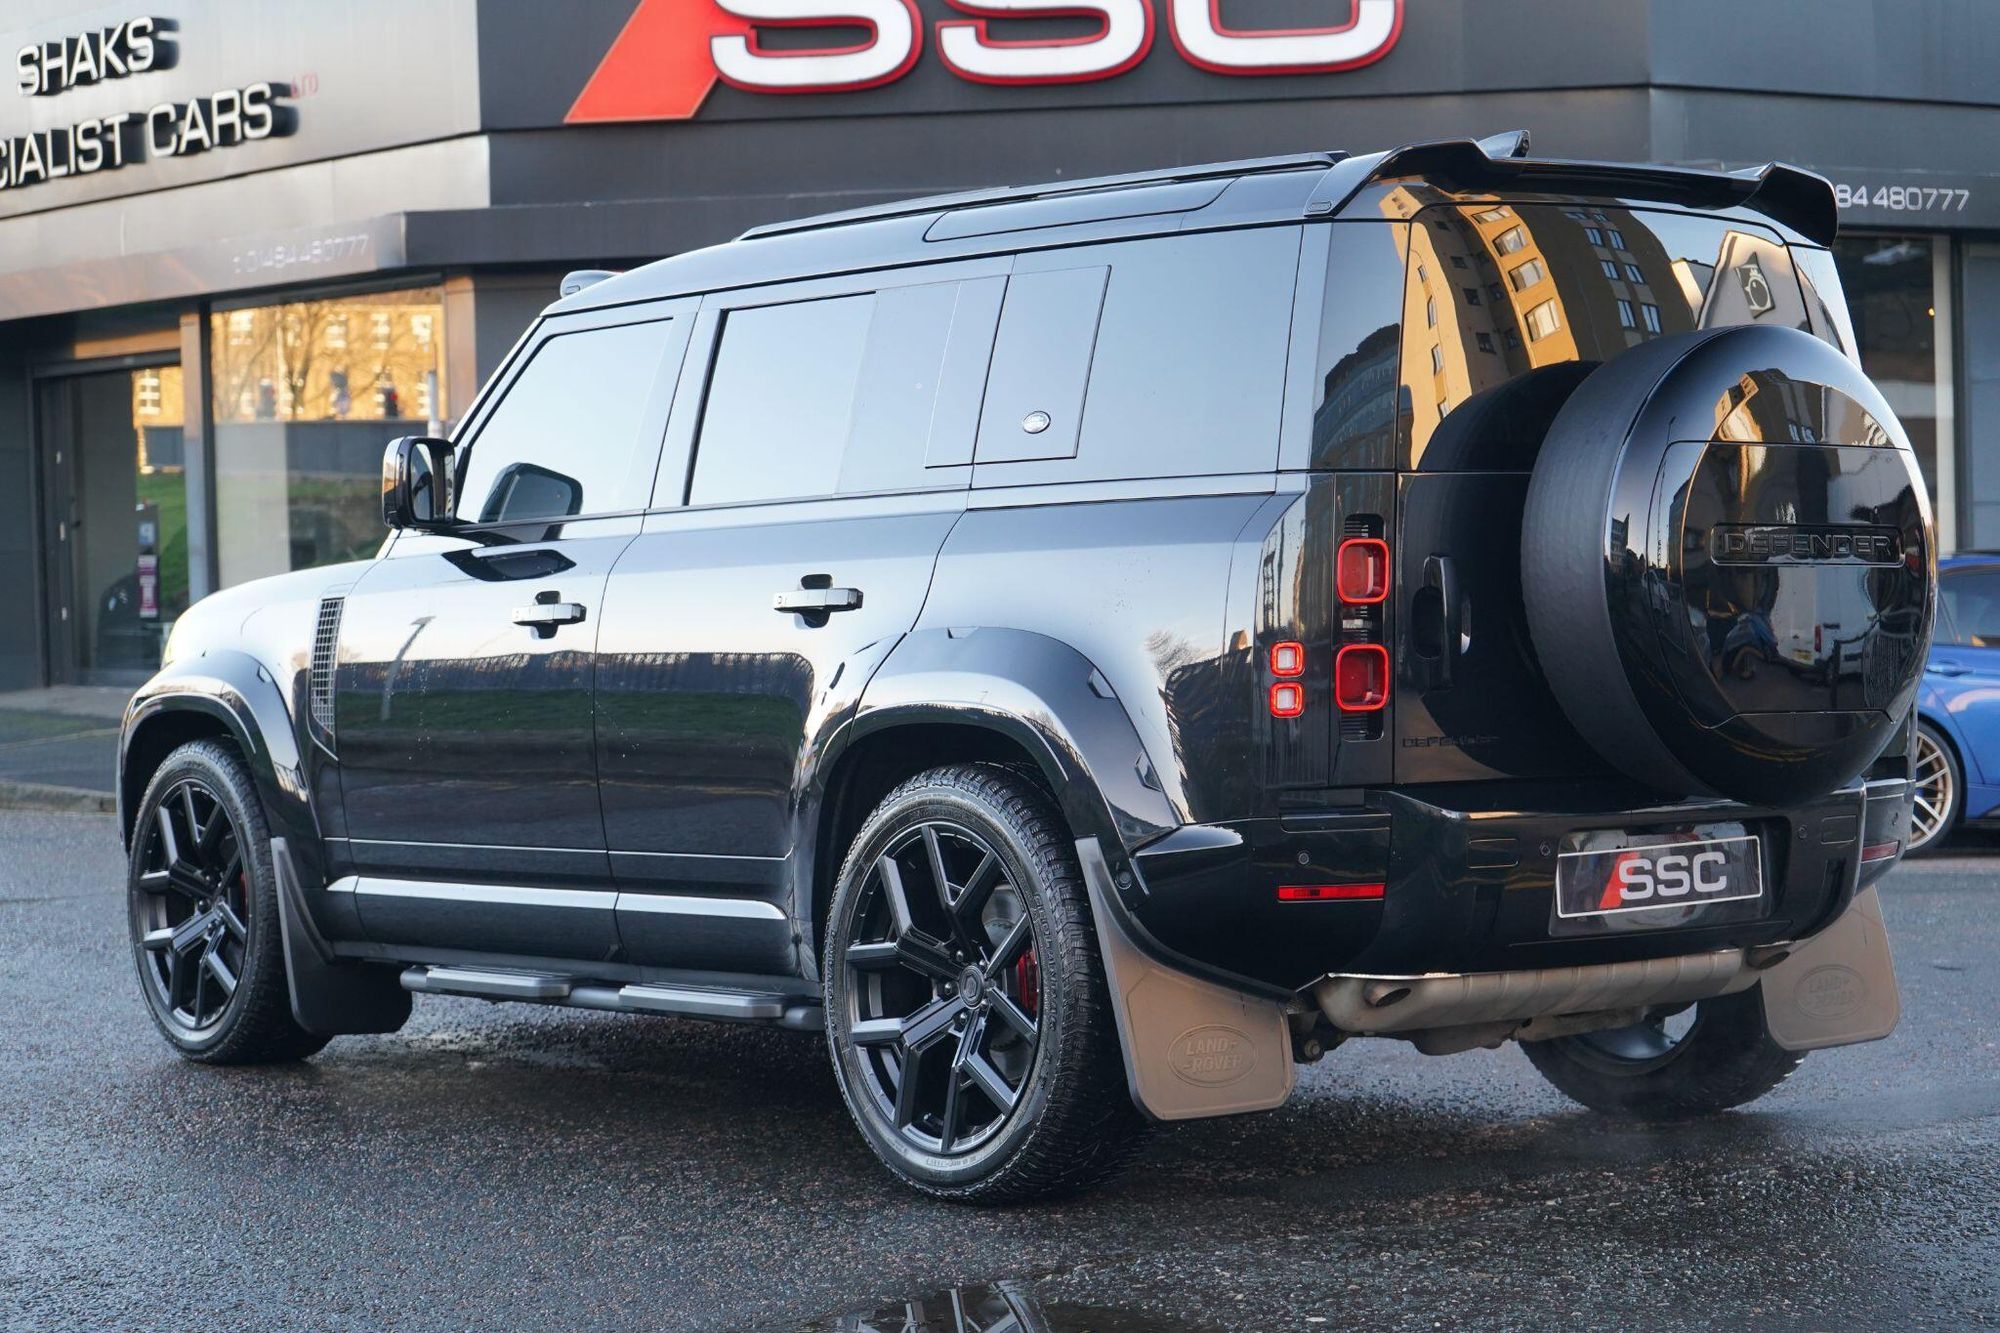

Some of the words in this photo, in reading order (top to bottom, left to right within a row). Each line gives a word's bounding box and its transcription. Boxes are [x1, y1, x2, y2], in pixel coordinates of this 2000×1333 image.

[16, 16, 155, 96] SHAKS
[147, 82, 273, 158] CARS
[1723, 532, 1892, 556] DEFENDER
[1402, 734, 1500, 748] DEFE
[1618, 851, 1728, 900] SSC
